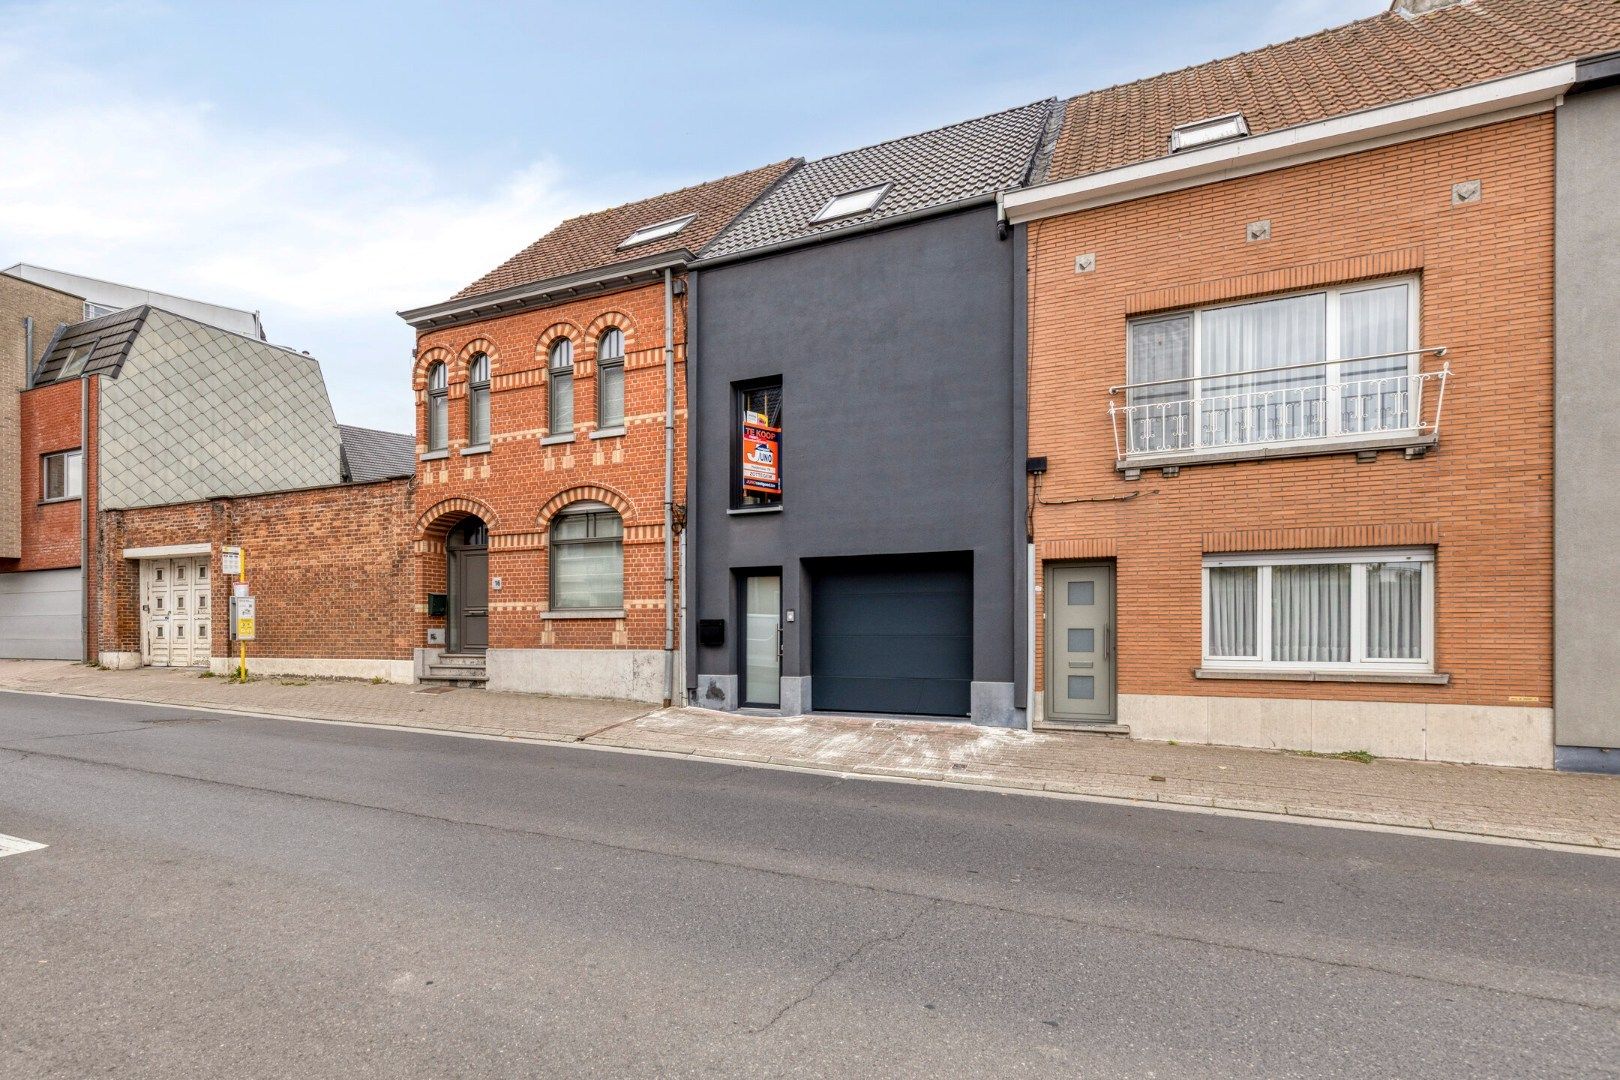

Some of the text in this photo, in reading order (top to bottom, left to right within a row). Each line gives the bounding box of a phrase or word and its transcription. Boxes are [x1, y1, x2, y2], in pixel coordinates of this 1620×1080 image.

[745, 427, 755, 436] TE
[756, 429, 776, 440] KOOP
[747, 449, 772, 463] JUNO
